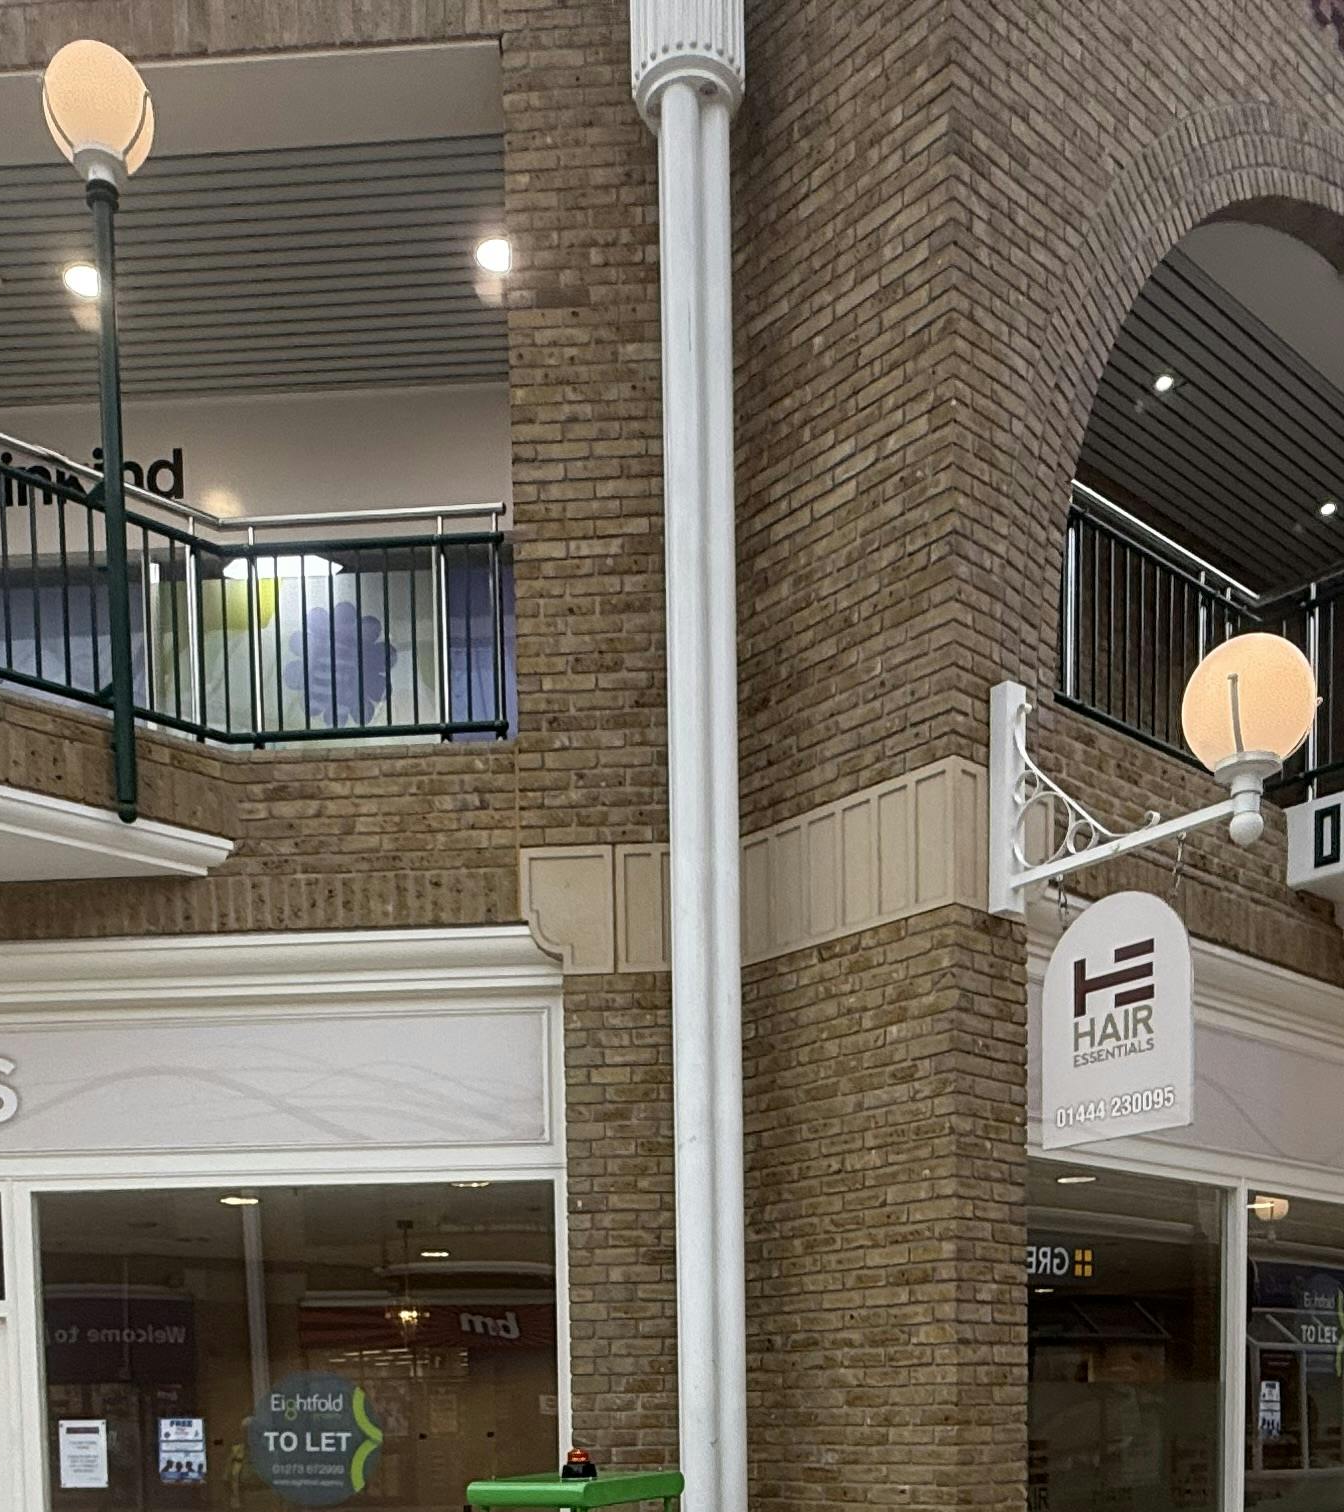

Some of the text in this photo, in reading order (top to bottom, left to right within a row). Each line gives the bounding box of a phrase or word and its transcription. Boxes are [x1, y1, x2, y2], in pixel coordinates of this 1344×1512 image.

[1073, 1004, 1154, 1053] HAIR
[1073, 1037, 1155, 1068] ESSENTIALS
[1056, 1086, 1175, 1128] 01444 230095
[270, 1393, 343, 1420] Eightfold
[263, 1431, 352, 1453] TO LET
